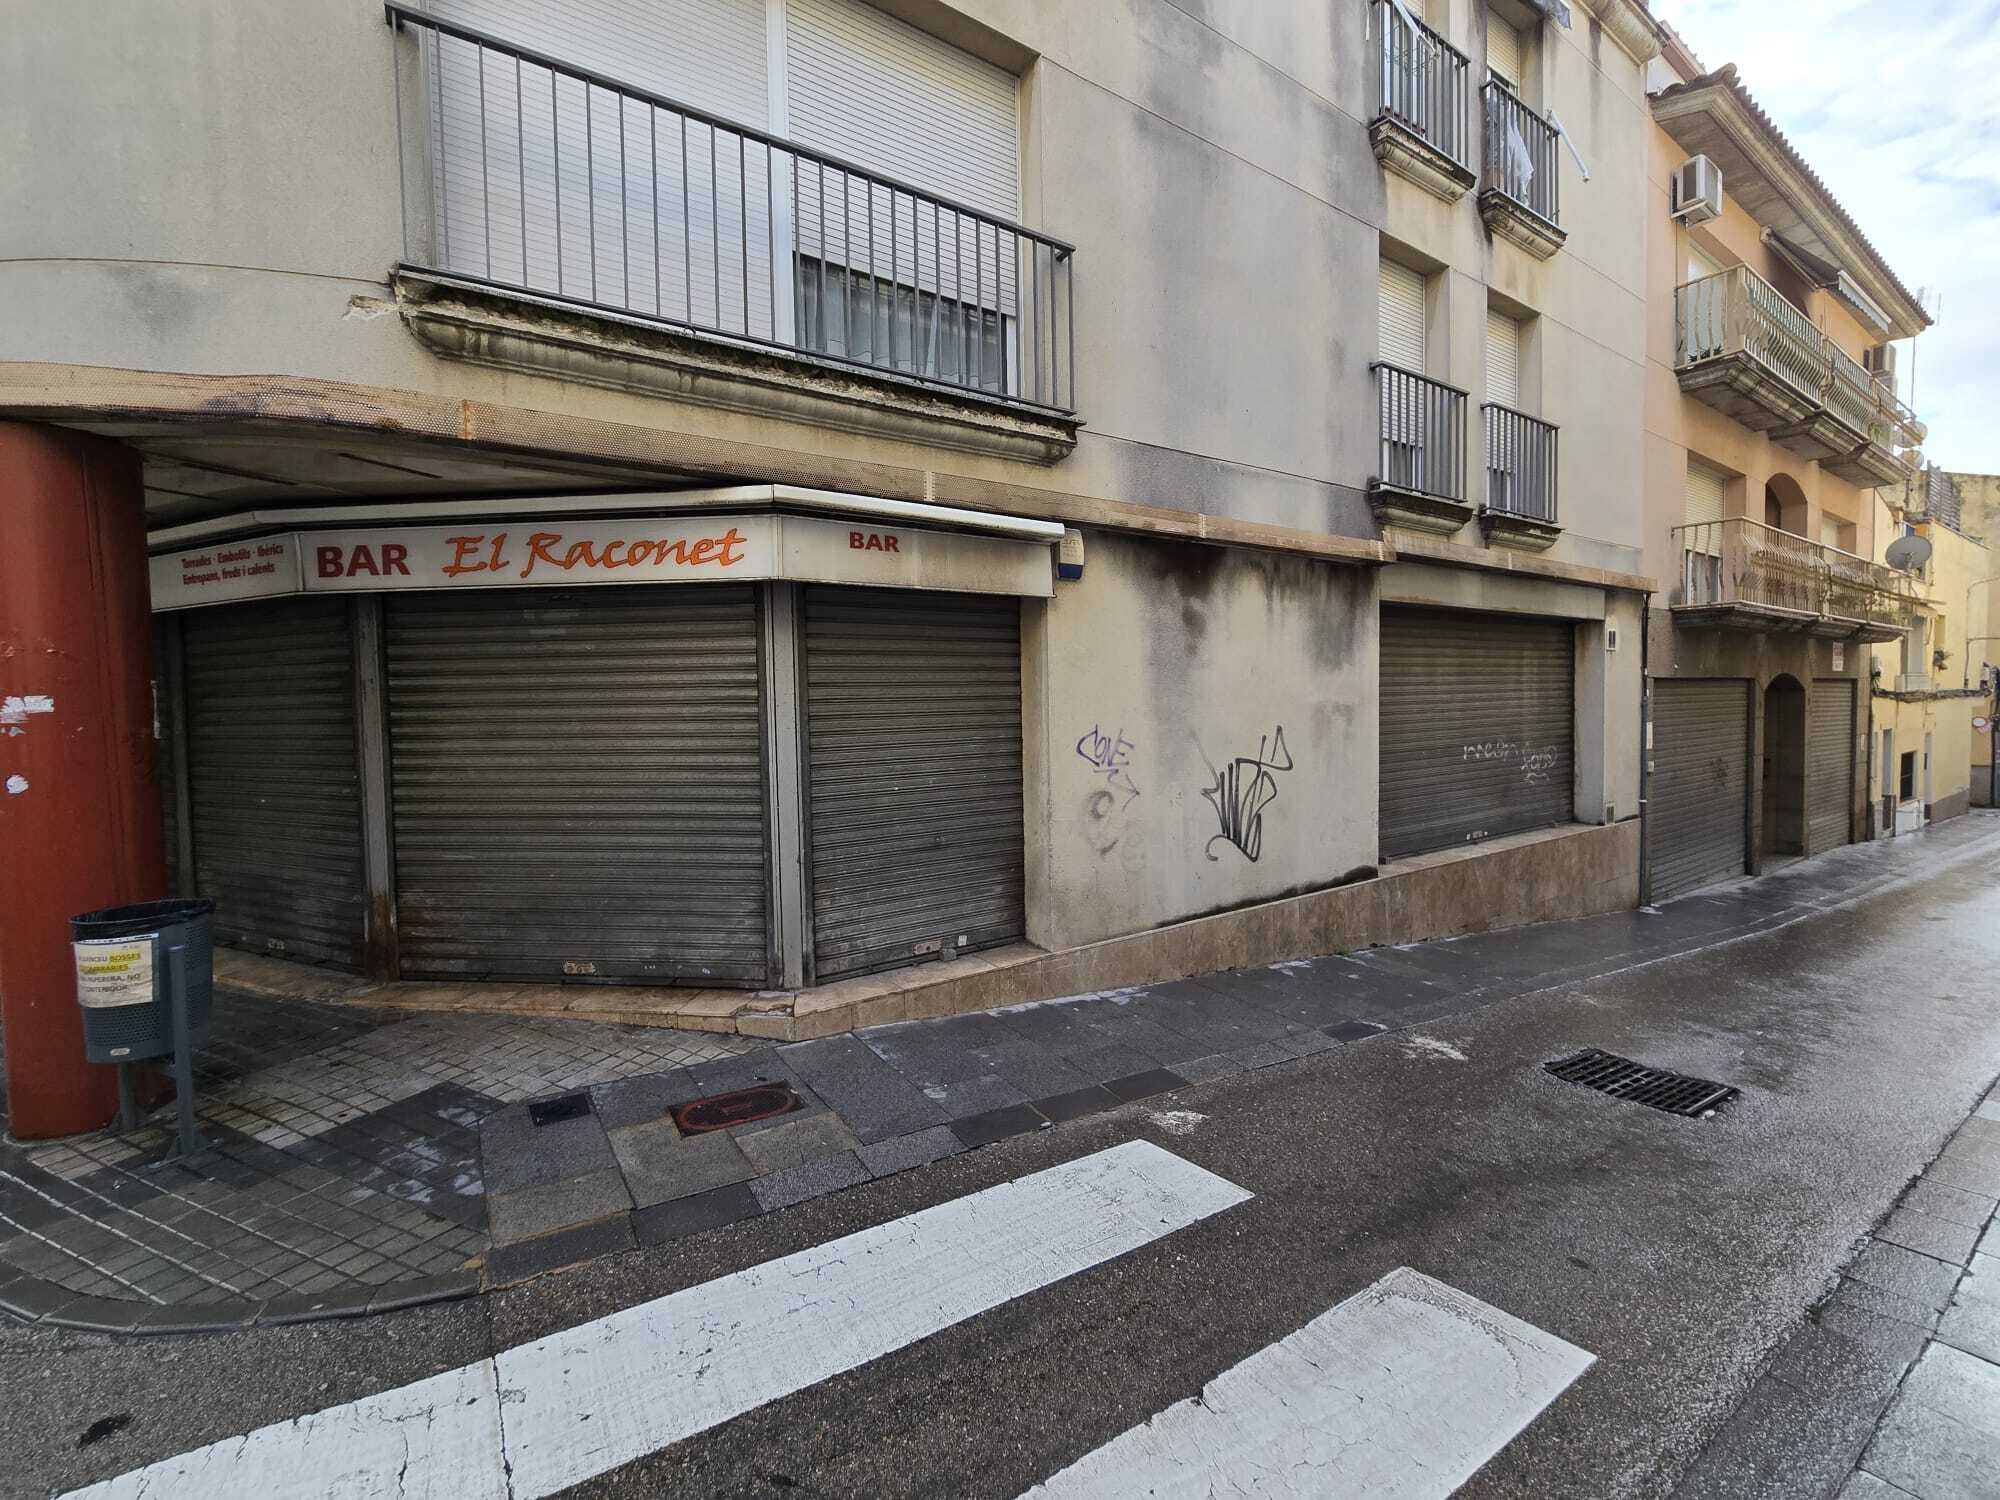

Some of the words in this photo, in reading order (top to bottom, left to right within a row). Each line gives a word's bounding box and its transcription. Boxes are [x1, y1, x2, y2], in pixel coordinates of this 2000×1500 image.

[316, 543, 412, 578] BAR
[442, 532, 508, 577] El
[519, 527, 748, 578] Raconet
[849, 531, 900, 553] BAR
